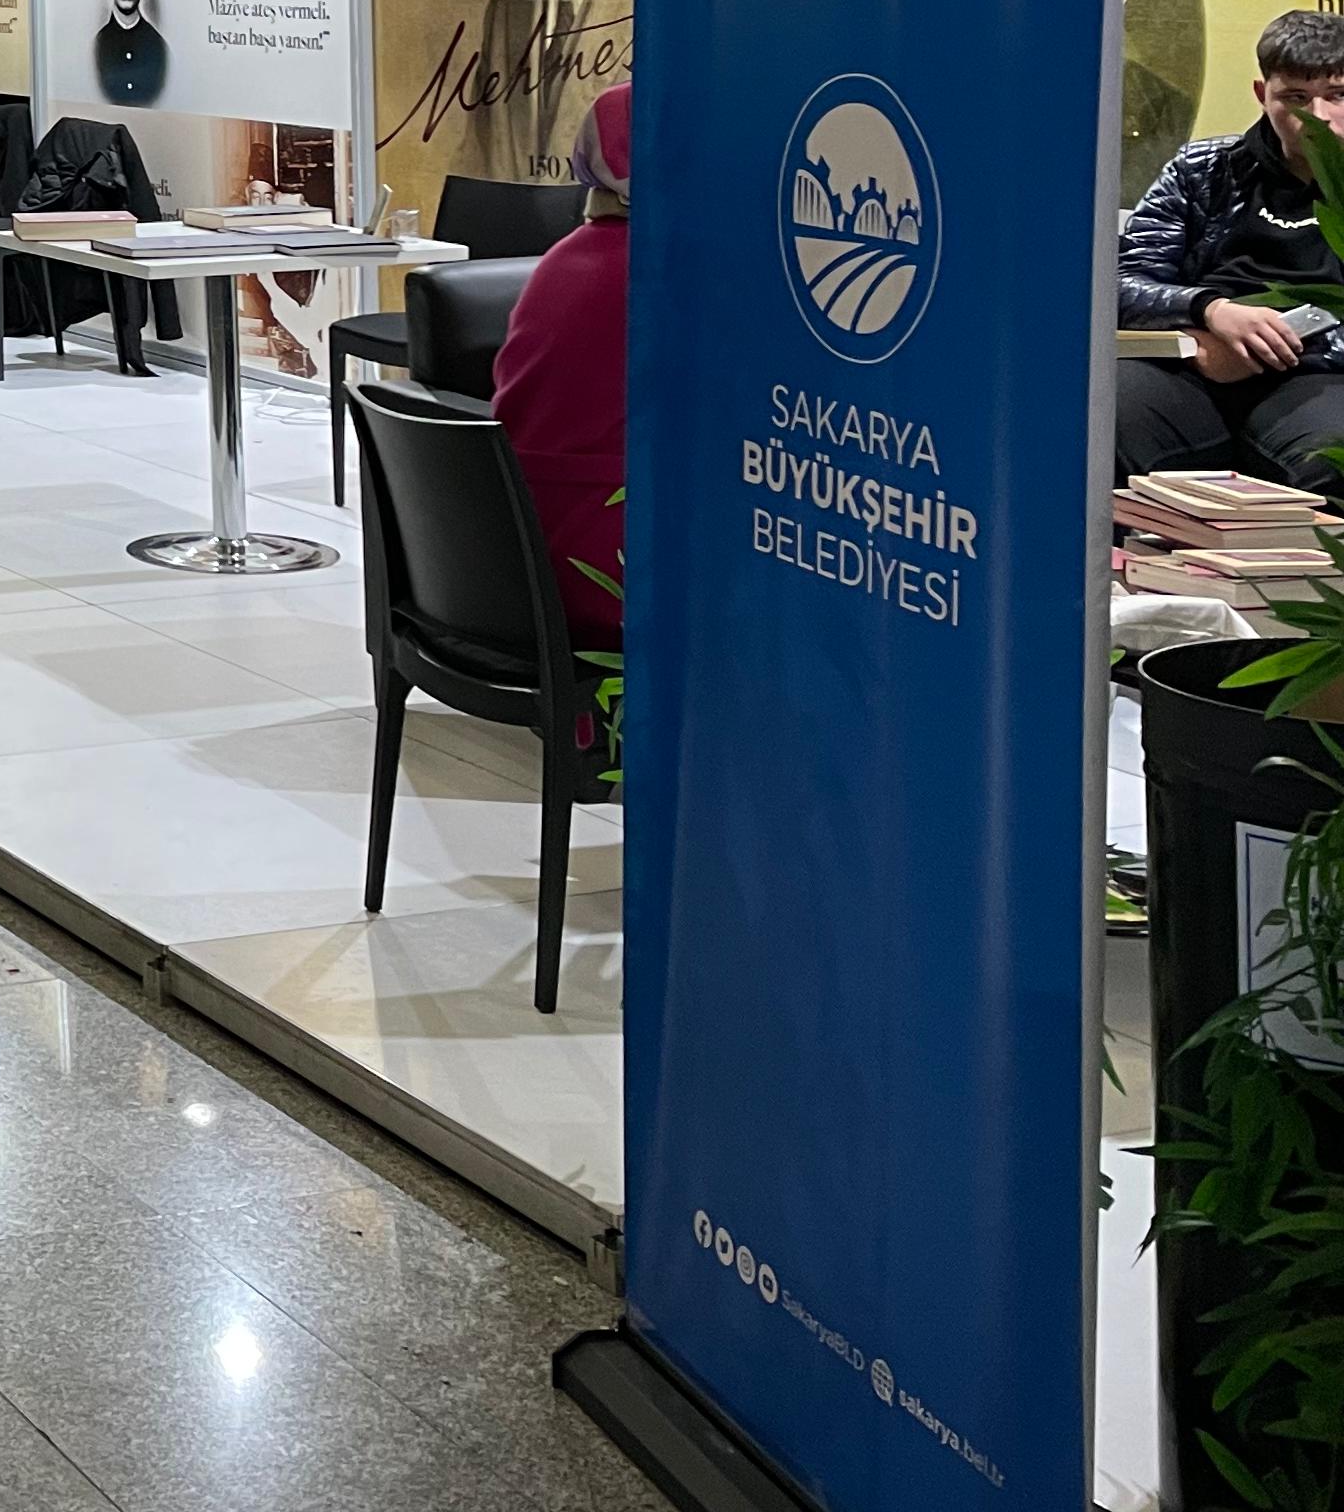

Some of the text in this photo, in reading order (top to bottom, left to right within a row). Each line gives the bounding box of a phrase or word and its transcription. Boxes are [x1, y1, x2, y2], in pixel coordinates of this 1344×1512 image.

[527, 154, 561, 180] 150
[771, 384, 941, 476] SAKARYA
[743, 437, 978, 560] BÜYÜKŞEHİR
[753, 507, 960, 627] BELEDİYESİ
